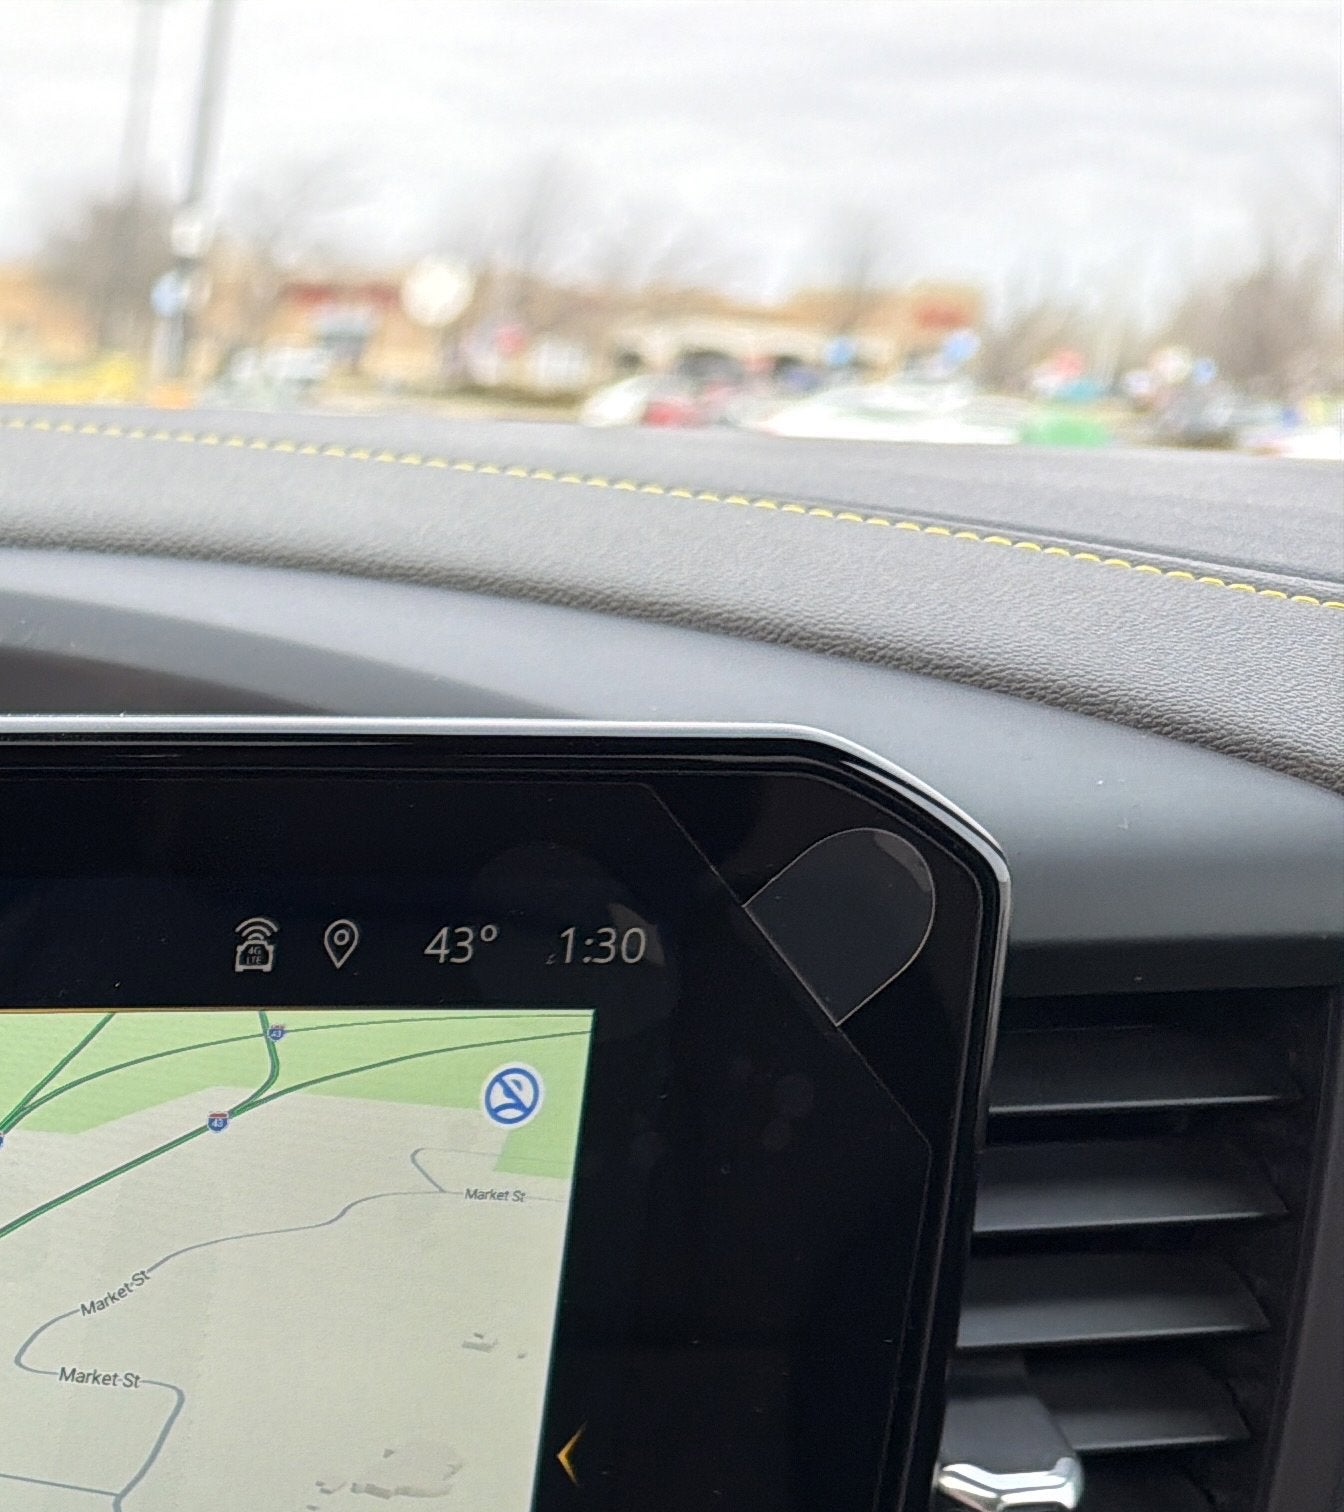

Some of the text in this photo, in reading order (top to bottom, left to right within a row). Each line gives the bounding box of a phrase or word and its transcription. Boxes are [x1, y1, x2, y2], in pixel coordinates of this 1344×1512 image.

[560, 926, 648, 964] 1:30
[465, 1187, 527, 1203] Market St
[80, 1267, 151, 1318] Market St
[58, 1366, 141, 1389] Market St
